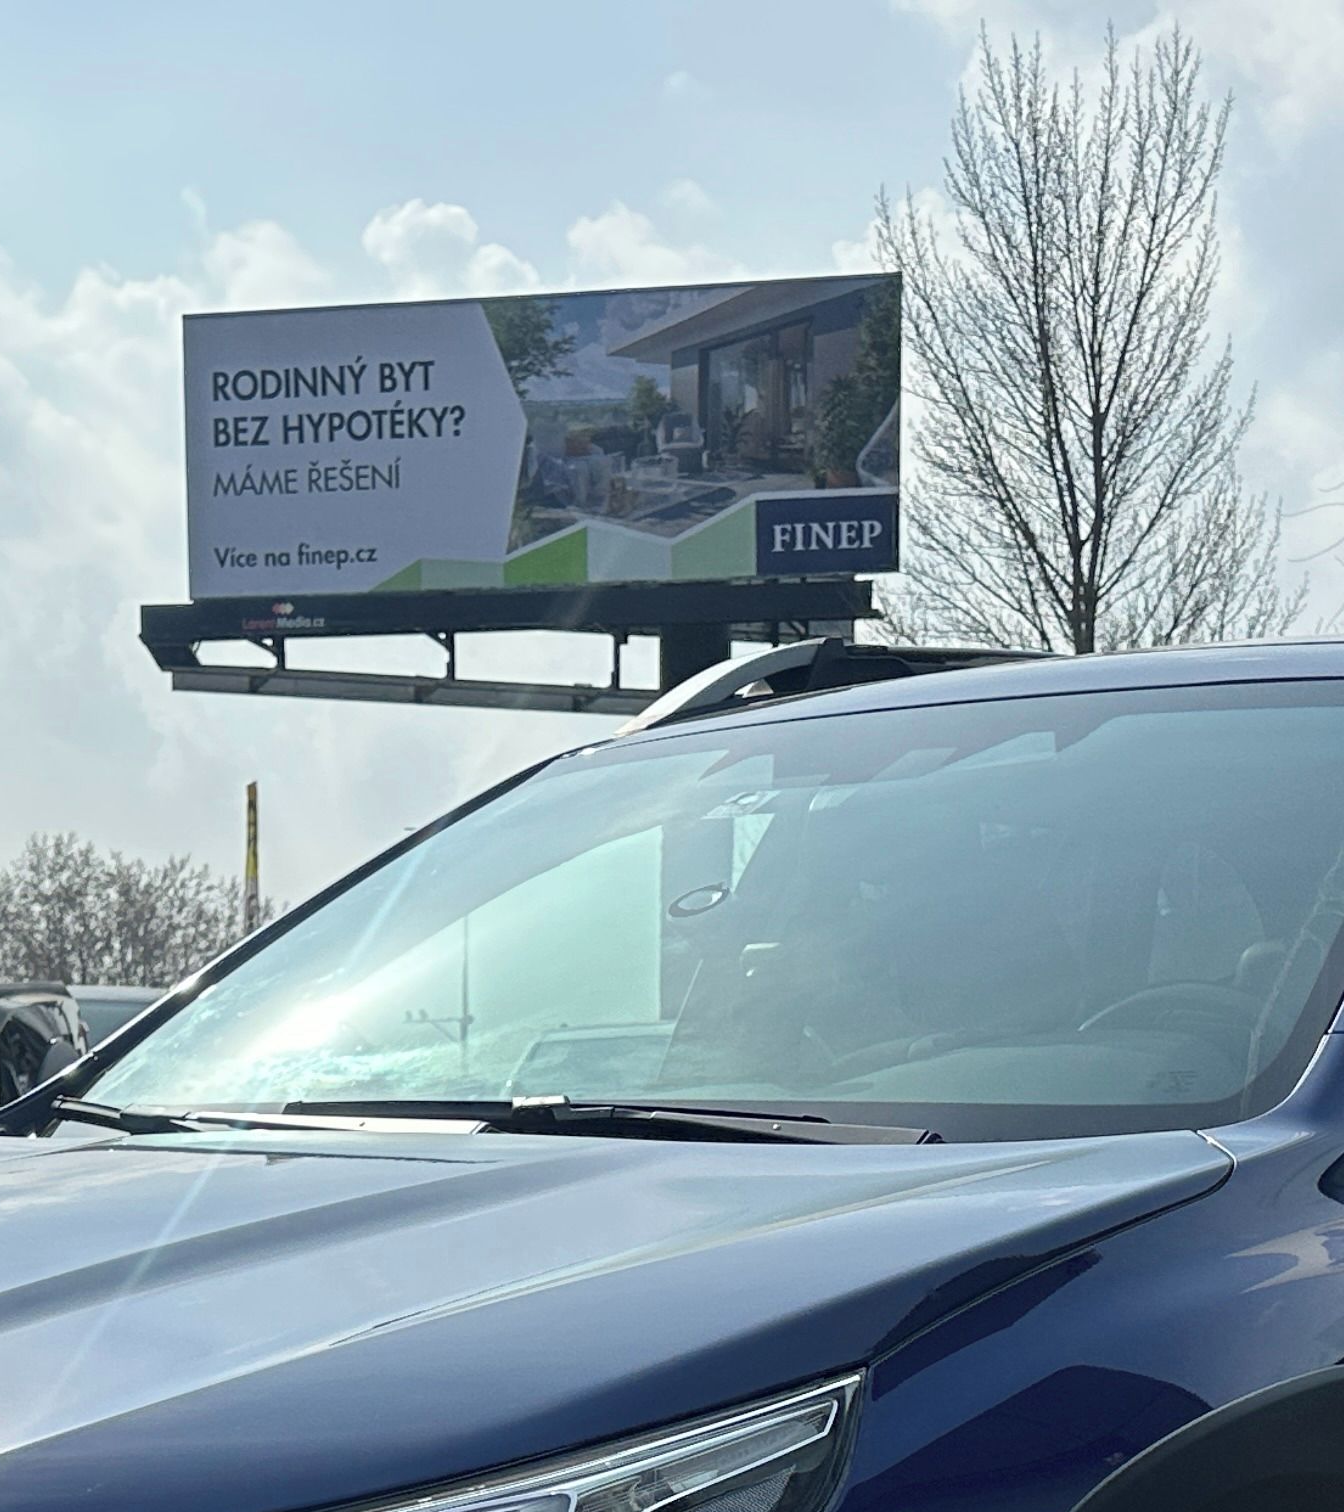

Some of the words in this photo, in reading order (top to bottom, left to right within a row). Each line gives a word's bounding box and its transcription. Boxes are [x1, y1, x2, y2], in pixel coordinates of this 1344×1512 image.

[212, 356, 368, 401] RODINNÝ
[379, 361, 435, 394] BYT
[213, 416, 270, 448] BEZ
[282, 400, 466, 445] HYPOTÉKY?
[213, 464, 299, 497] MÁME
[307, 457, 402, 493] ŘEŠENÍ
[213, 546, 258, 569] Více
[264, 551, 291, 568] na
[297, 542, 378, 571] finep.cz
[771, 520, 883, 553] FINEP
